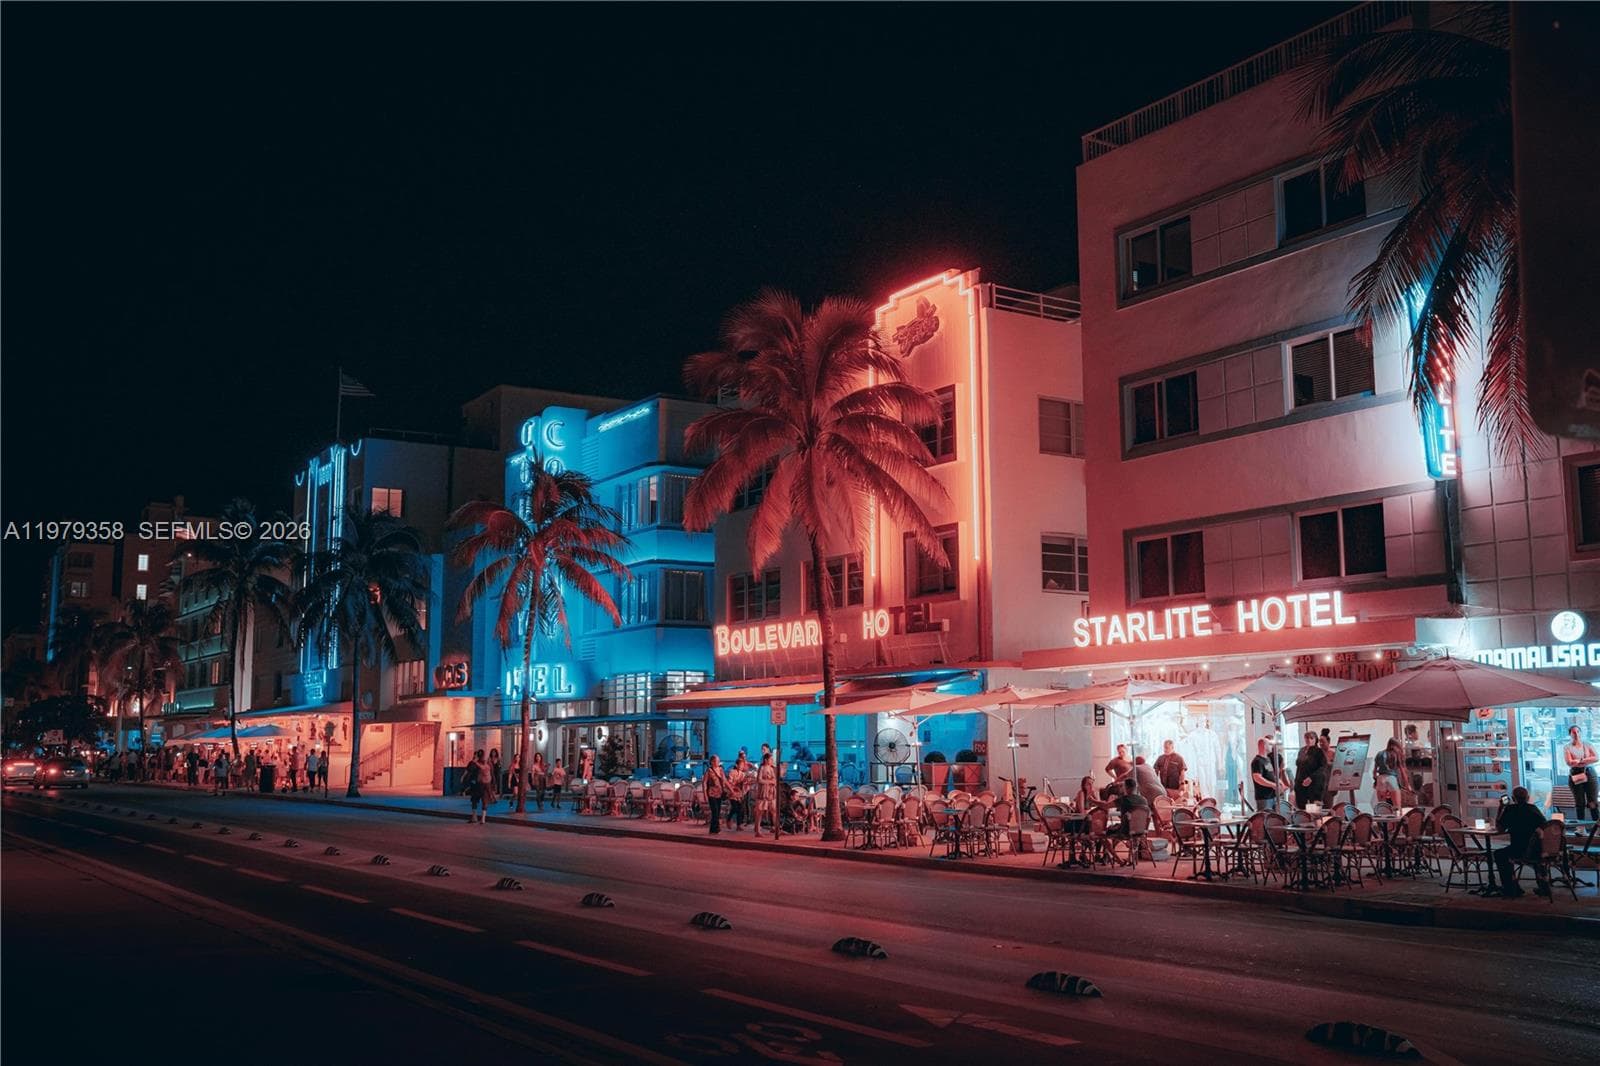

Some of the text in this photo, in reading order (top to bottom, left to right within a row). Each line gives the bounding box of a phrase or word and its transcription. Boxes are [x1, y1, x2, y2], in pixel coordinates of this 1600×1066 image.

[715, 603, 943, 656] BOULEVAR HOTEL
[1072, 590, 1356, 648] STARLITE HOTEL
[1473, 644, 1586, 670] MAMALISA
